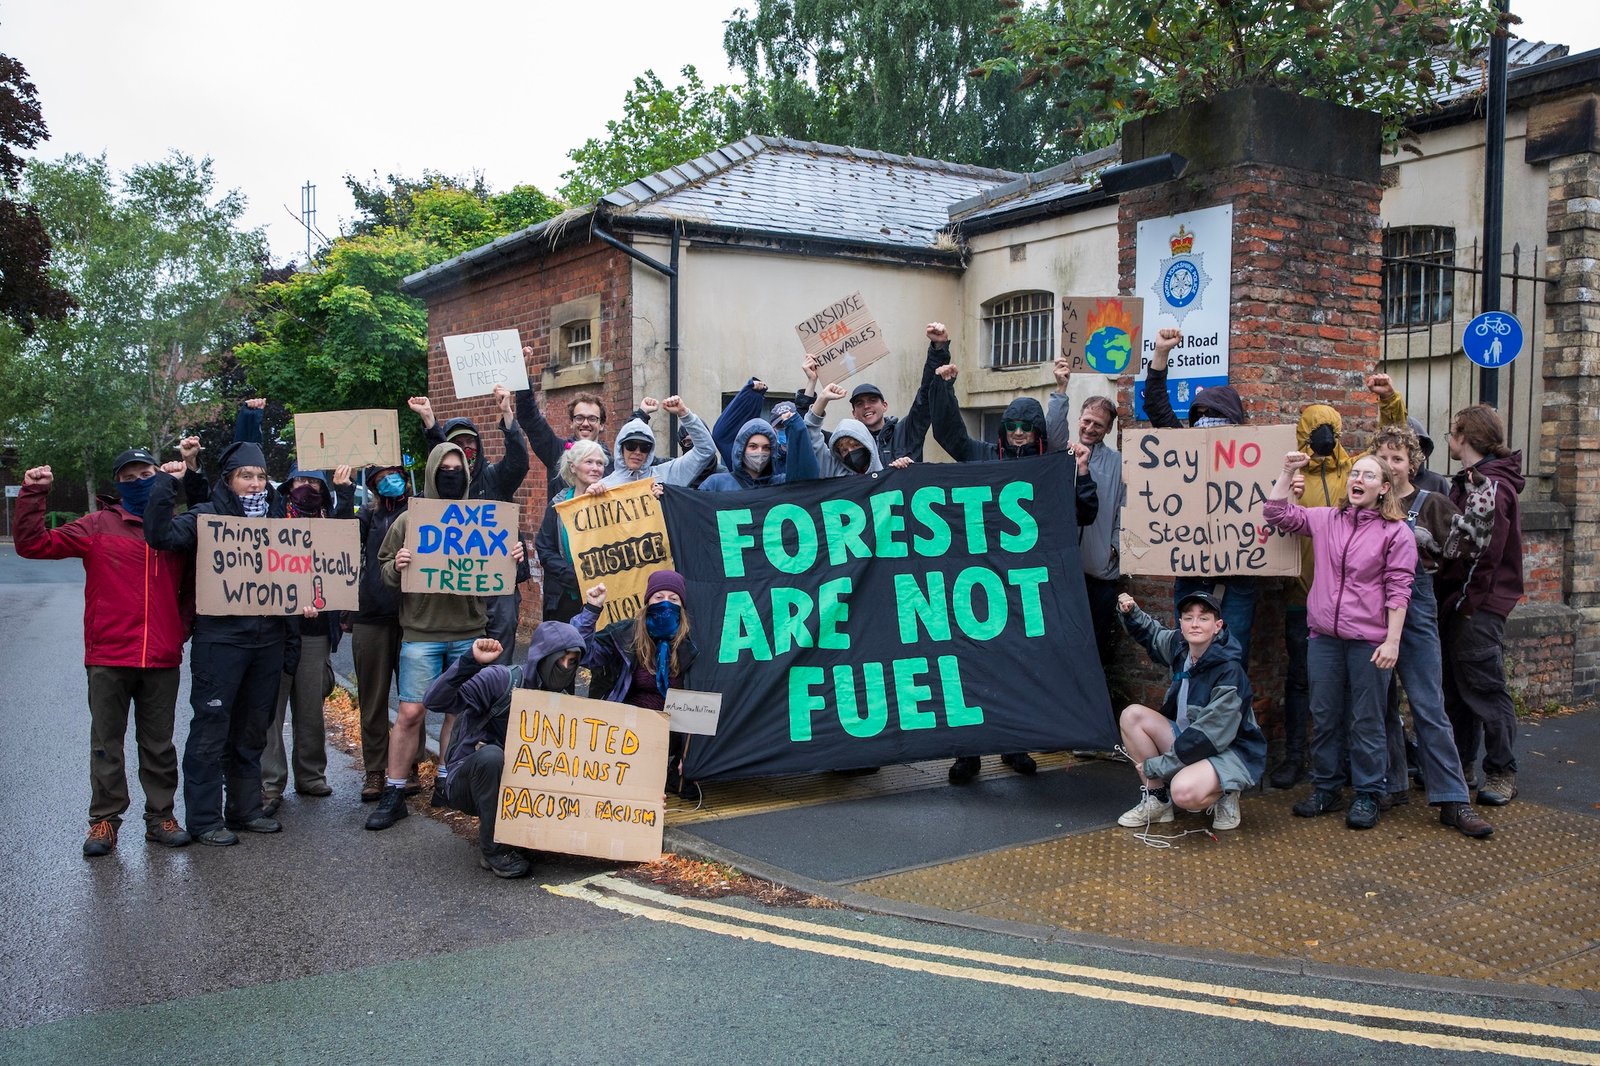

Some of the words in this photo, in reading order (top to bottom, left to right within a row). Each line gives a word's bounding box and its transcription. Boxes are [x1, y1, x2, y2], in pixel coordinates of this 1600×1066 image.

[798, 294, 865, 340] SUBSIDISE
[818, 320, 852, 346] REAL
[463, 332, 499, 351] STOP
[1187, 332, 1218, 349] Road
[456, 348, 516, 371] BURNING
[1177, 352, 1220, 368] Station
[468, 368, 508, 387] TREES
[1138, 434, 1198, 483] Say
[1214, 439, 1261, 472] NO
[574, 494, 655, 532] CLIMATE
[1139, 480, 1182, 516] to
[1206, 479, 1277, 515] DRA
[440, 503, 498, 527] AXE
[716, 481, 1038, 578] FORESTS
[208, 521, 270, 550] Things
[278, 527, 312, 548] are
[417, 525, 508, 557] DRAX
[1149, 518, 1255, 548] Stealing
[213, 547, 262, 574] going
[268, 548, 358, 586] Draxtically
[447, 557, 489, 572] NOT
[583, 535, 667, 578] JUSTICE
[223, 579, 298, 613] wrong
[419, 568, 504, 592] TREES
[718, 577, 853, 664] ARE
[894, 566, 1049, 644] NOT
[789, 655, 985, 742] FUEL
[519, 709, 640, 756] UNITED
[512, 744, 631, 786] AGAINST
[501, 786, 580, 821] RACISM
[595, 800, 656, 828] FACISM
